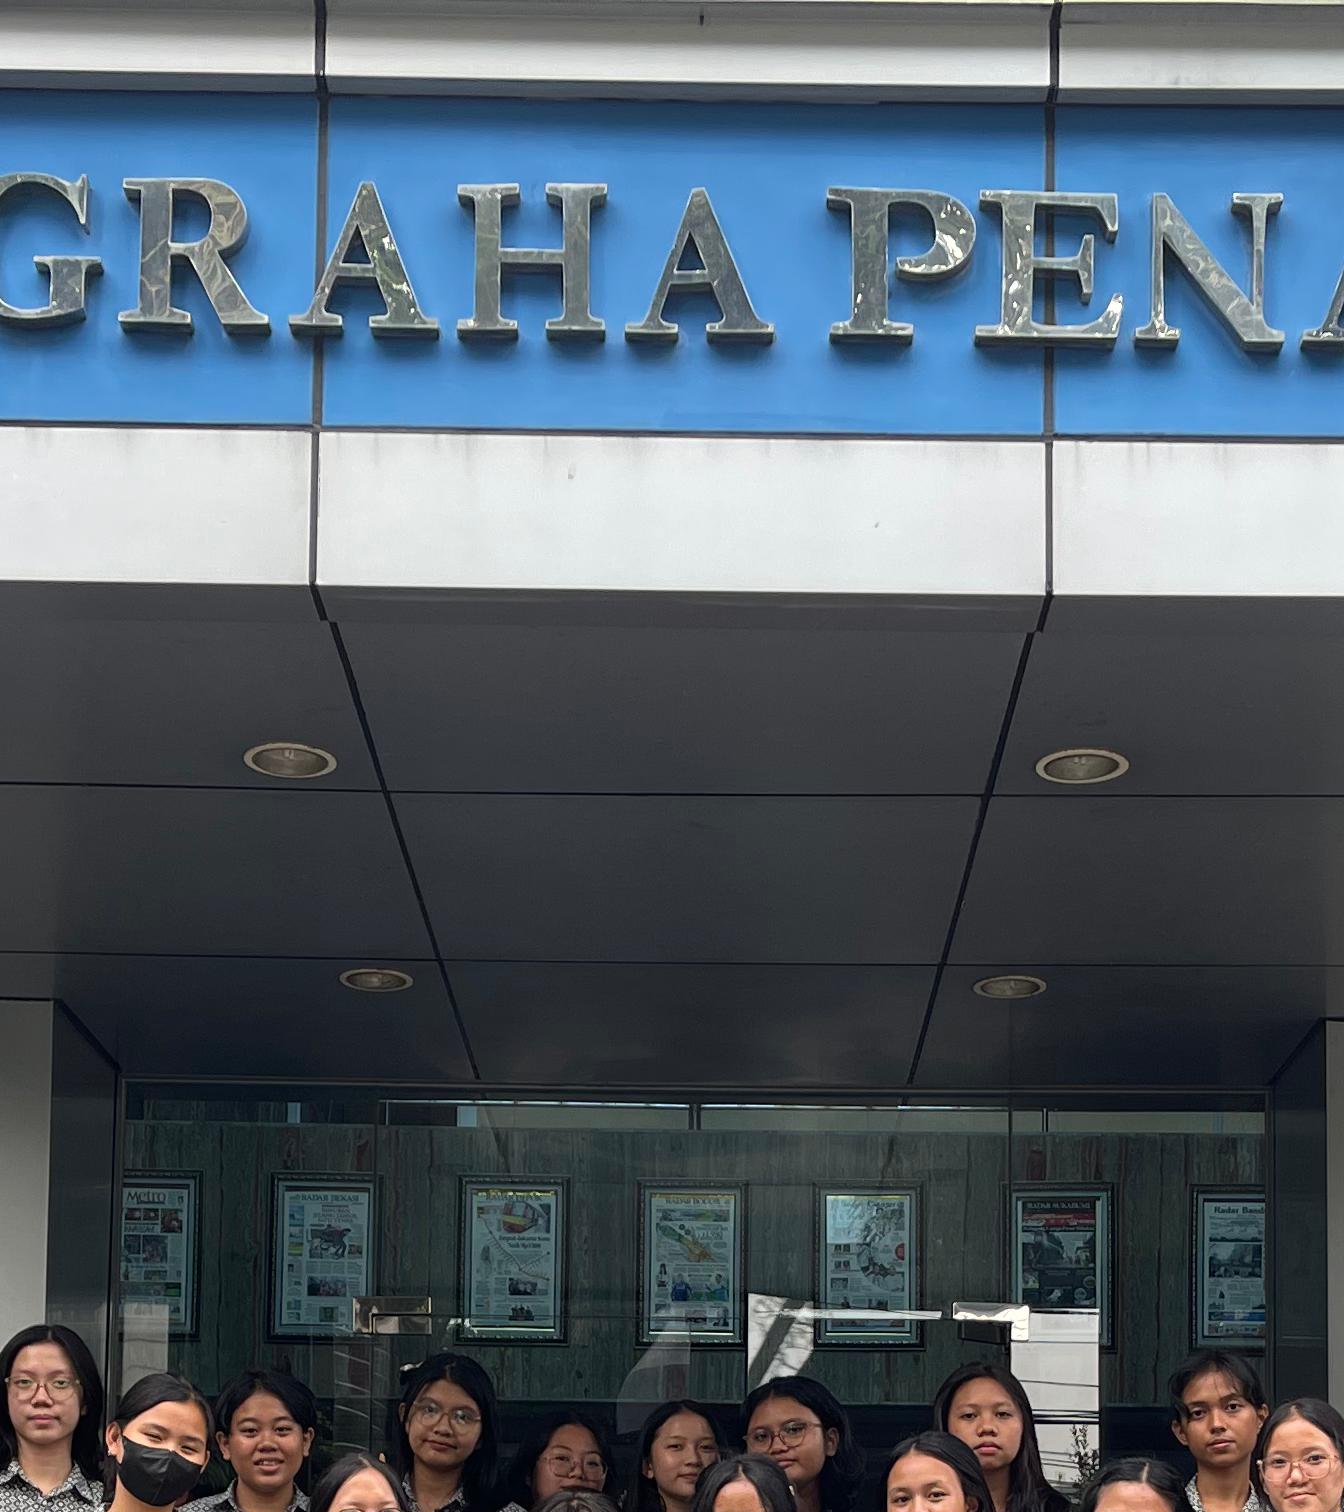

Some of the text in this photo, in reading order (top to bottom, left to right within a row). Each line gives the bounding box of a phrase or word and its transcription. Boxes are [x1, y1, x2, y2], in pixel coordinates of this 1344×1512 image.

[127, 1191, 167, 1203] Metro
[301, 1193, 329, 1202] RADAR
[1214, 1206, 1240, 1214] Radar
